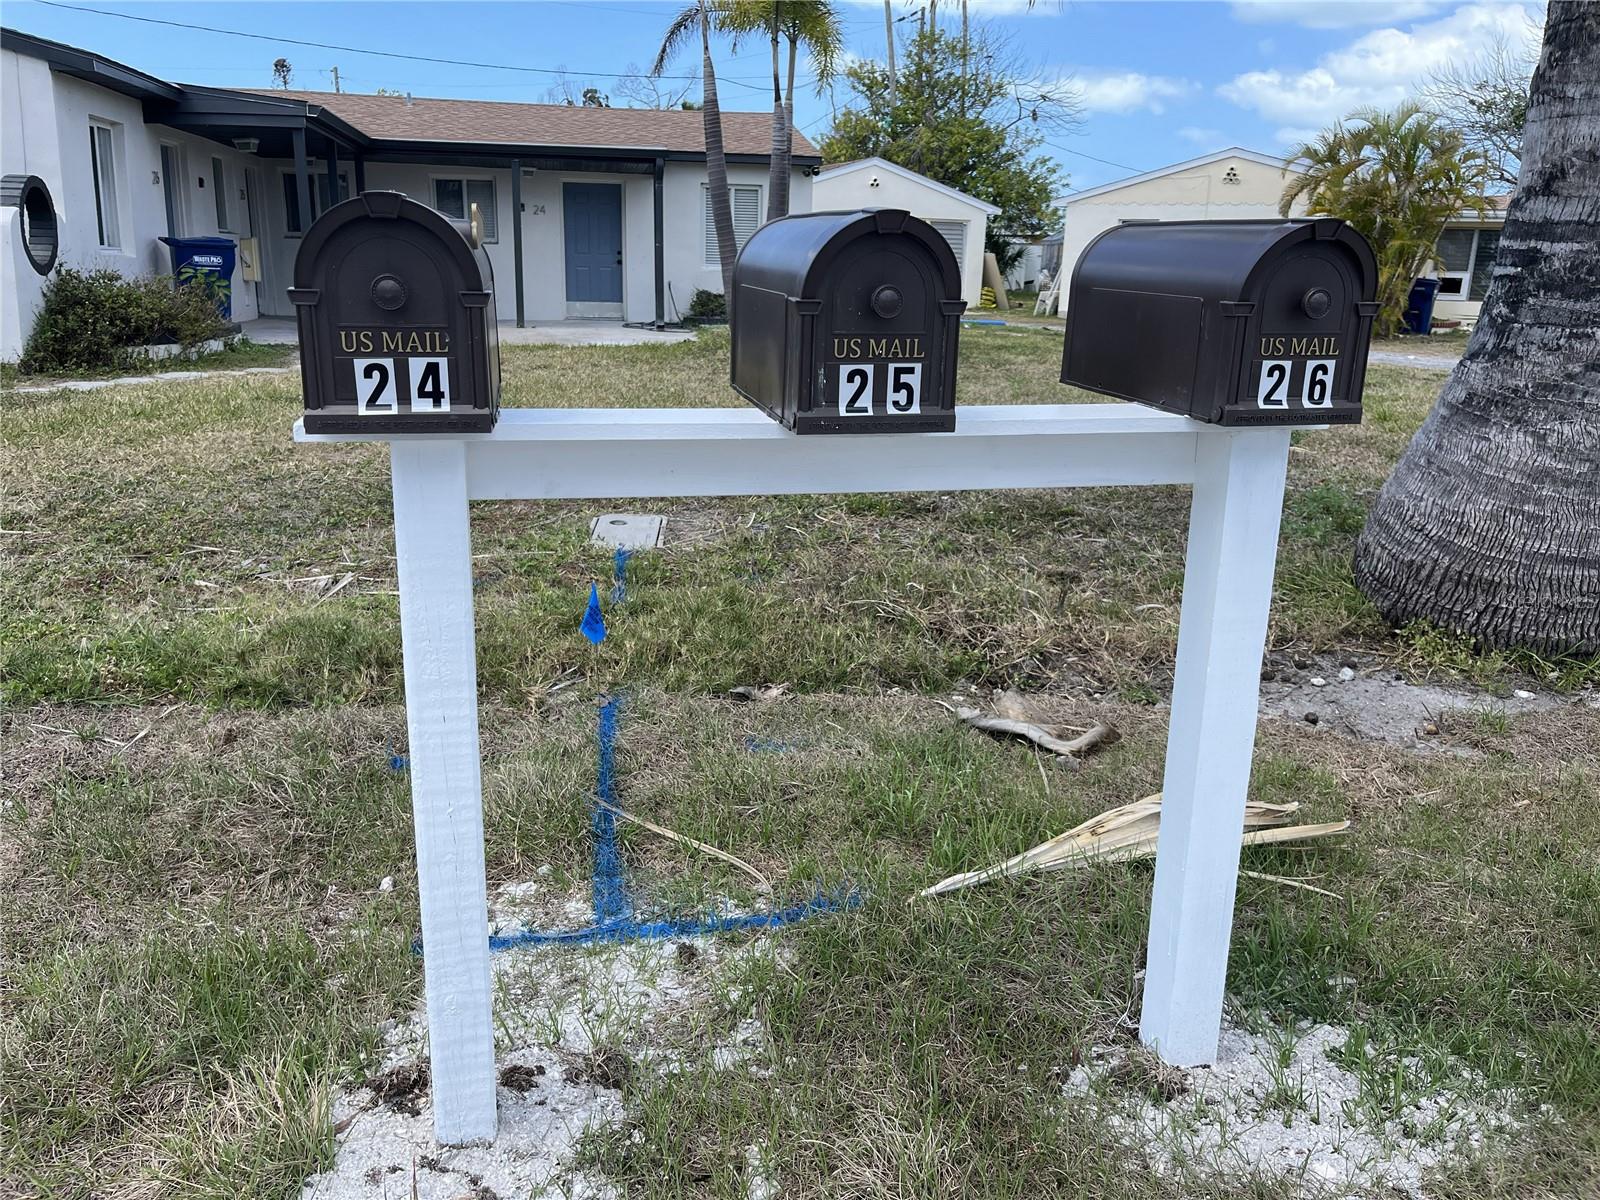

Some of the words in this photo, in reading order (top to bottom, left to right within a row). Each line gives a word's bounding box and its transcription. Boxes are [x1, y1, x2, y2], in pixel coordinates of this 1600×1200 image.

[532, 204, 546, 216] 24
[340, 331, 373, 353] US
[381, 331, 449, 353] MAIL
[833, 338, 862, 358] US
[868, 338, 925, 358] MAIL
[1260, 337, 1286, 356] US
[1289, 337, 1340, 356] MAIL
